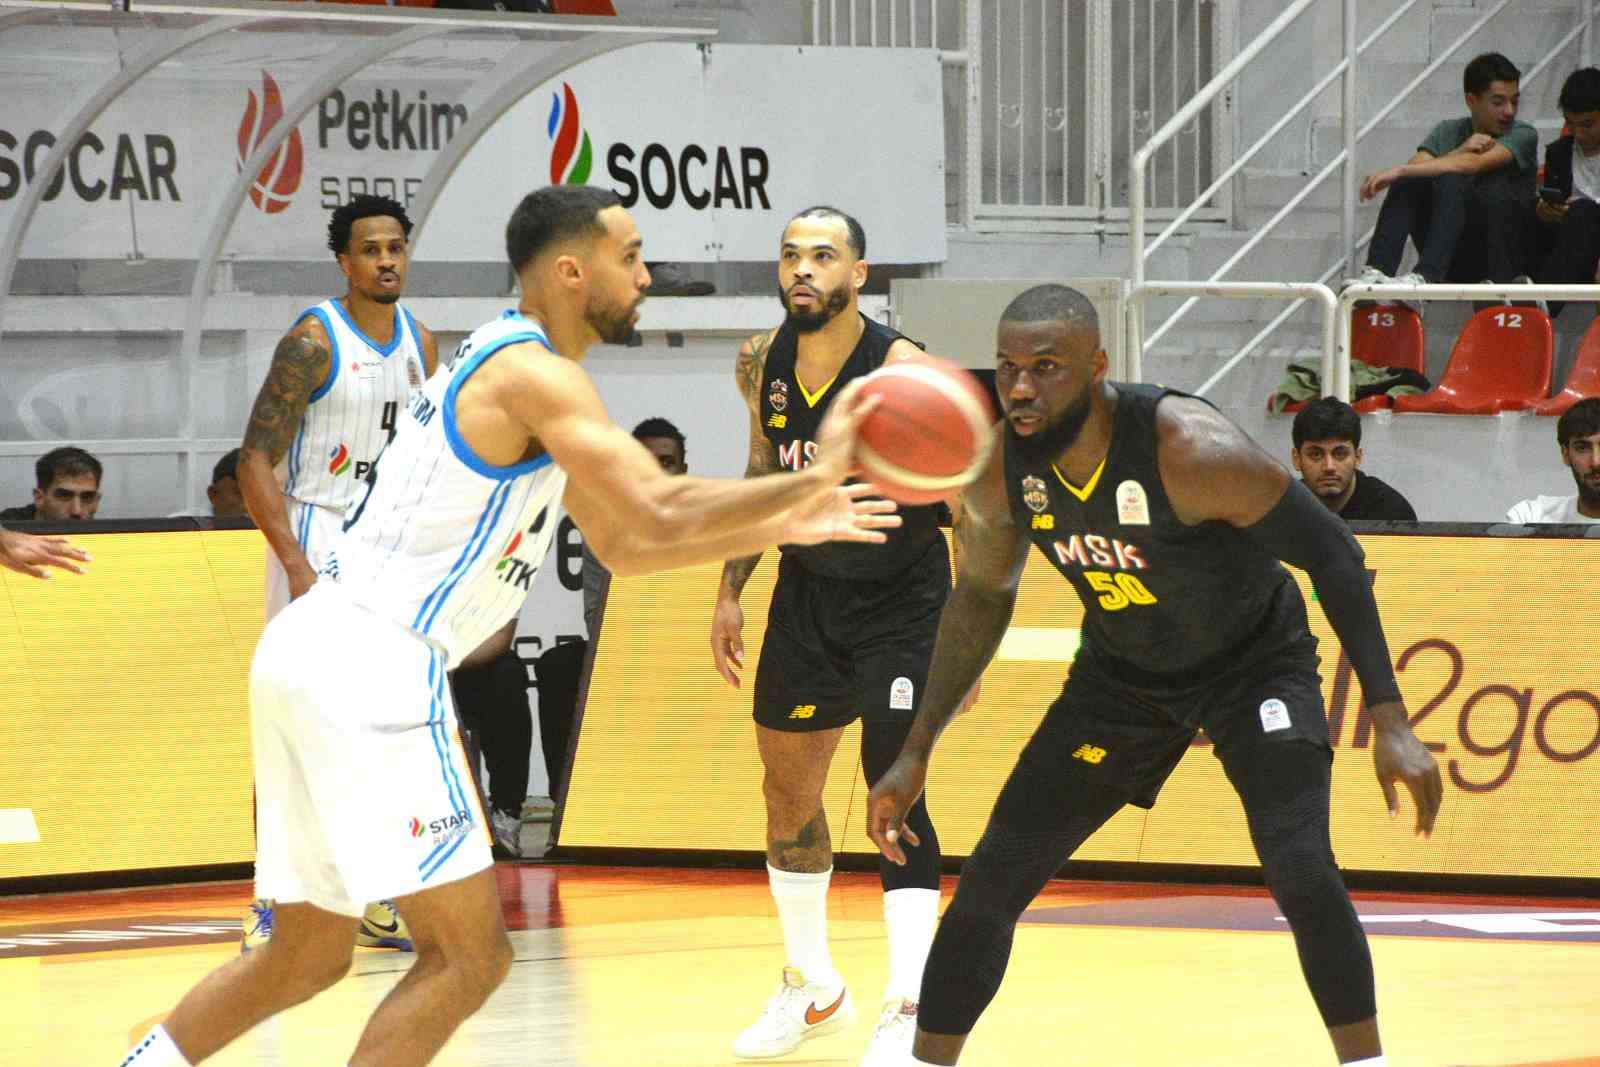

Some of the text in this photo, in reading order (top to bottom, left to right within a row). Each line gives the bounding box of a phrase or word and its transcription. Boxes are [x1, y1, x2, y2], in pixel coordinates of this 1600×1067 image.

[318, 87, 468, 150] Petkim
[0, 129, 182, 202] SOCAR
[606, 142, 772, 210] SOCAR
[1367, 312, 1395, 327] 13
[1493, 313, 1523, 328] 12
[778, 439, 819, 471] MS
[1053, 533, 1149, 569] MSK
[1082, 570, 1159, 611] 50
[429, 810, 468, 834] STAR
